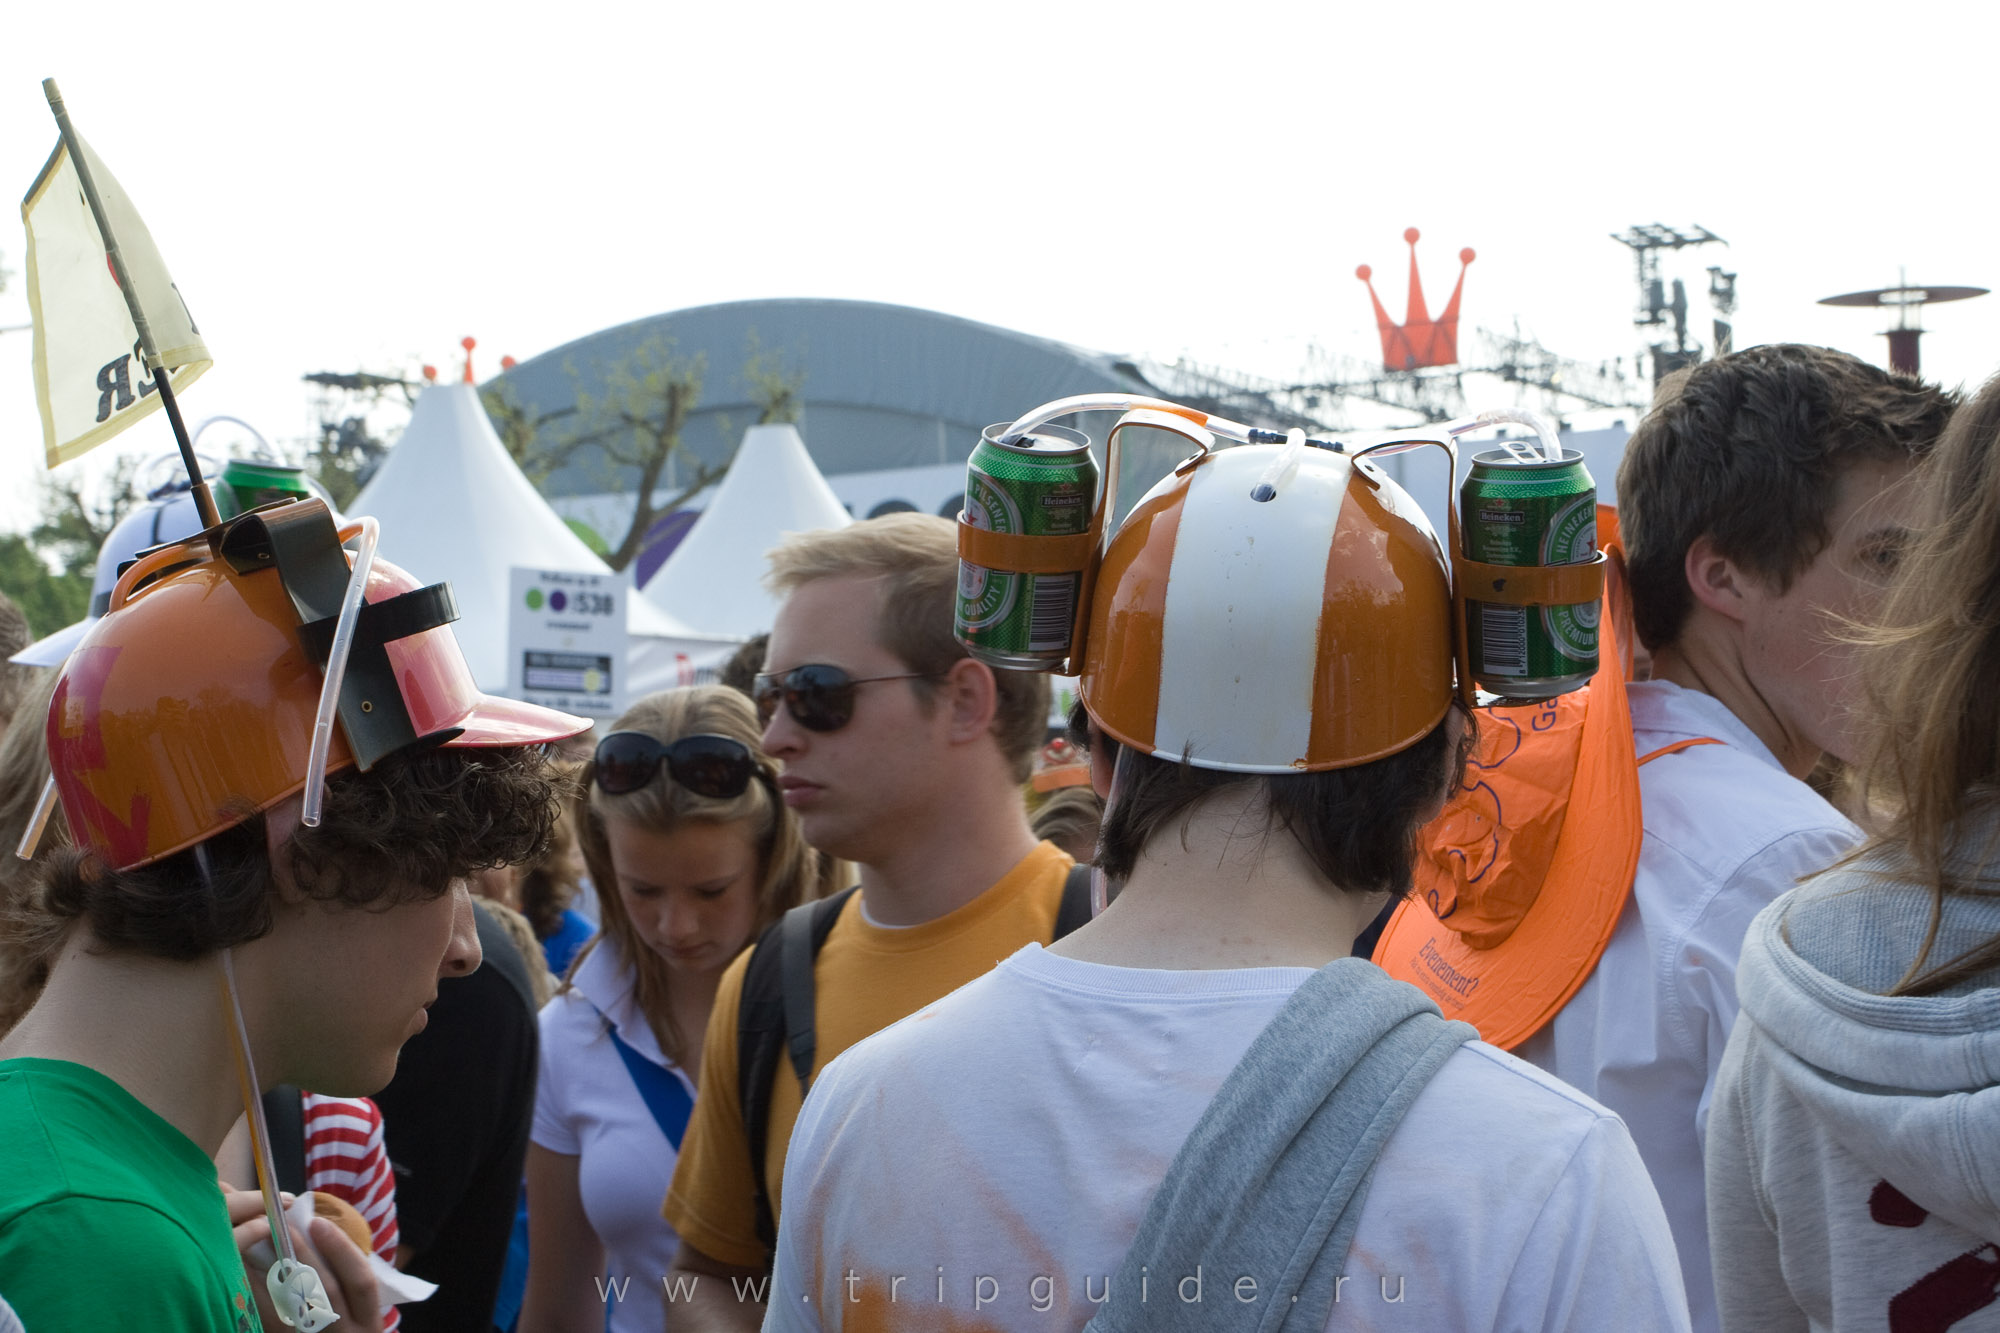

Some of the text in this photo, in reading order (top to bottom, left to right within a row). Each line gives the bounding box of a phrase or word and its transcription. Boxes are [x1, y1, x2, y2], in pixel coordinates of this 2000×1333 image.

[974, 483, 1007, 533] PILSENER
[1481, 511, 1521, 522] Heineken
[964, 585, 1000, 616] QUALITY
[1558, 610, 1595, 645] PREMIUM
[1419, 937, 1479, 998] Evenement?
